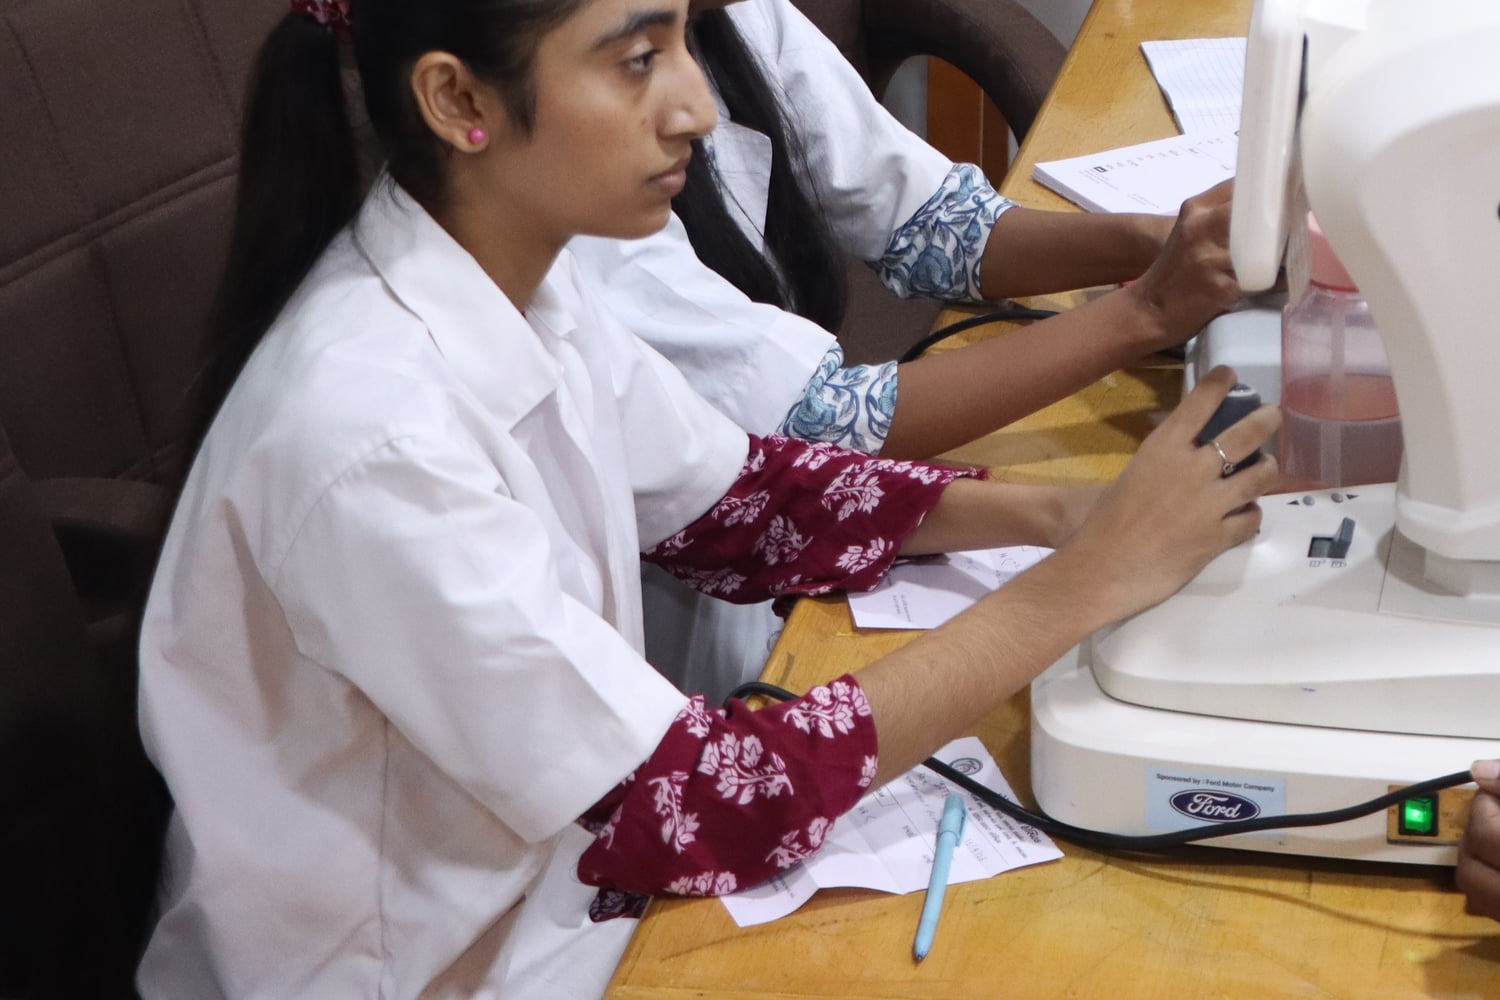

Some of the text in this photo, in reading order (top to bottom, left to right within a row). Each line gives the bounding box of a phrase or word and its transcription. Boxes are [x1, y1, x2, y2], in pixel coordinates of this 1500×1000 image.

[1156, 773, 1191, 783] Sponsored
[1192, 777, 1200, 786] by
[1206, 779, 1221, 787] Ford
[1222, 781, 1242, 789] Motor
[1243, 783, 1274, 792] Company
[1187, 793, 1241, 818] Ford
